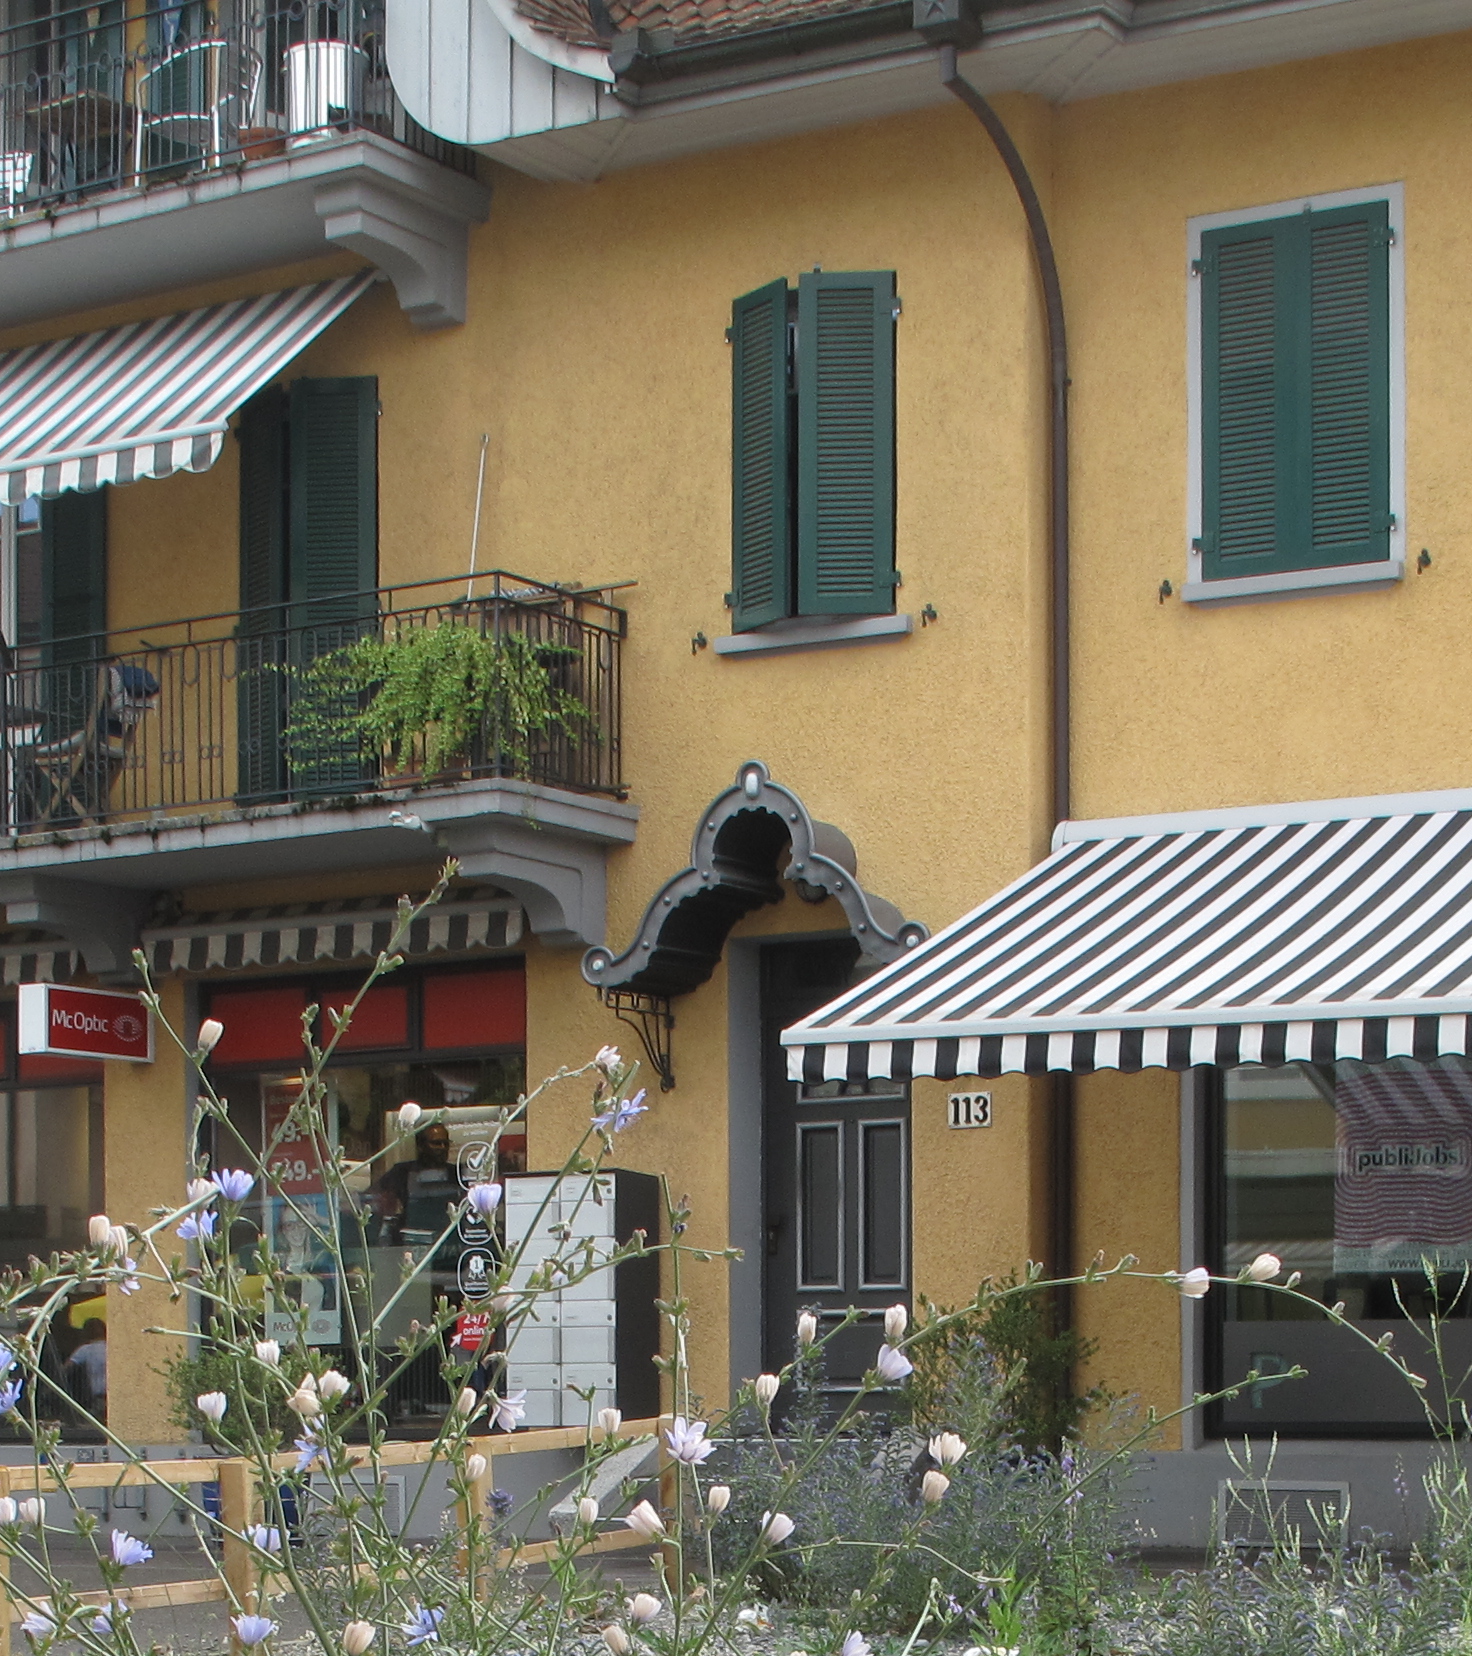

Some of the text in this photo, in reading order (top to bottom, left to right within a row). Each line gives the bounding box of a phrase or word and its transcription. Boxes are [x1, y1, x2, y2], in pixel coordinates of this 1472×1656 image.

[51, 1008, 109, 1034] McOptic
[950, 1095, 989, 1125] 113
[462, 1325, 486, 1336] onlin
